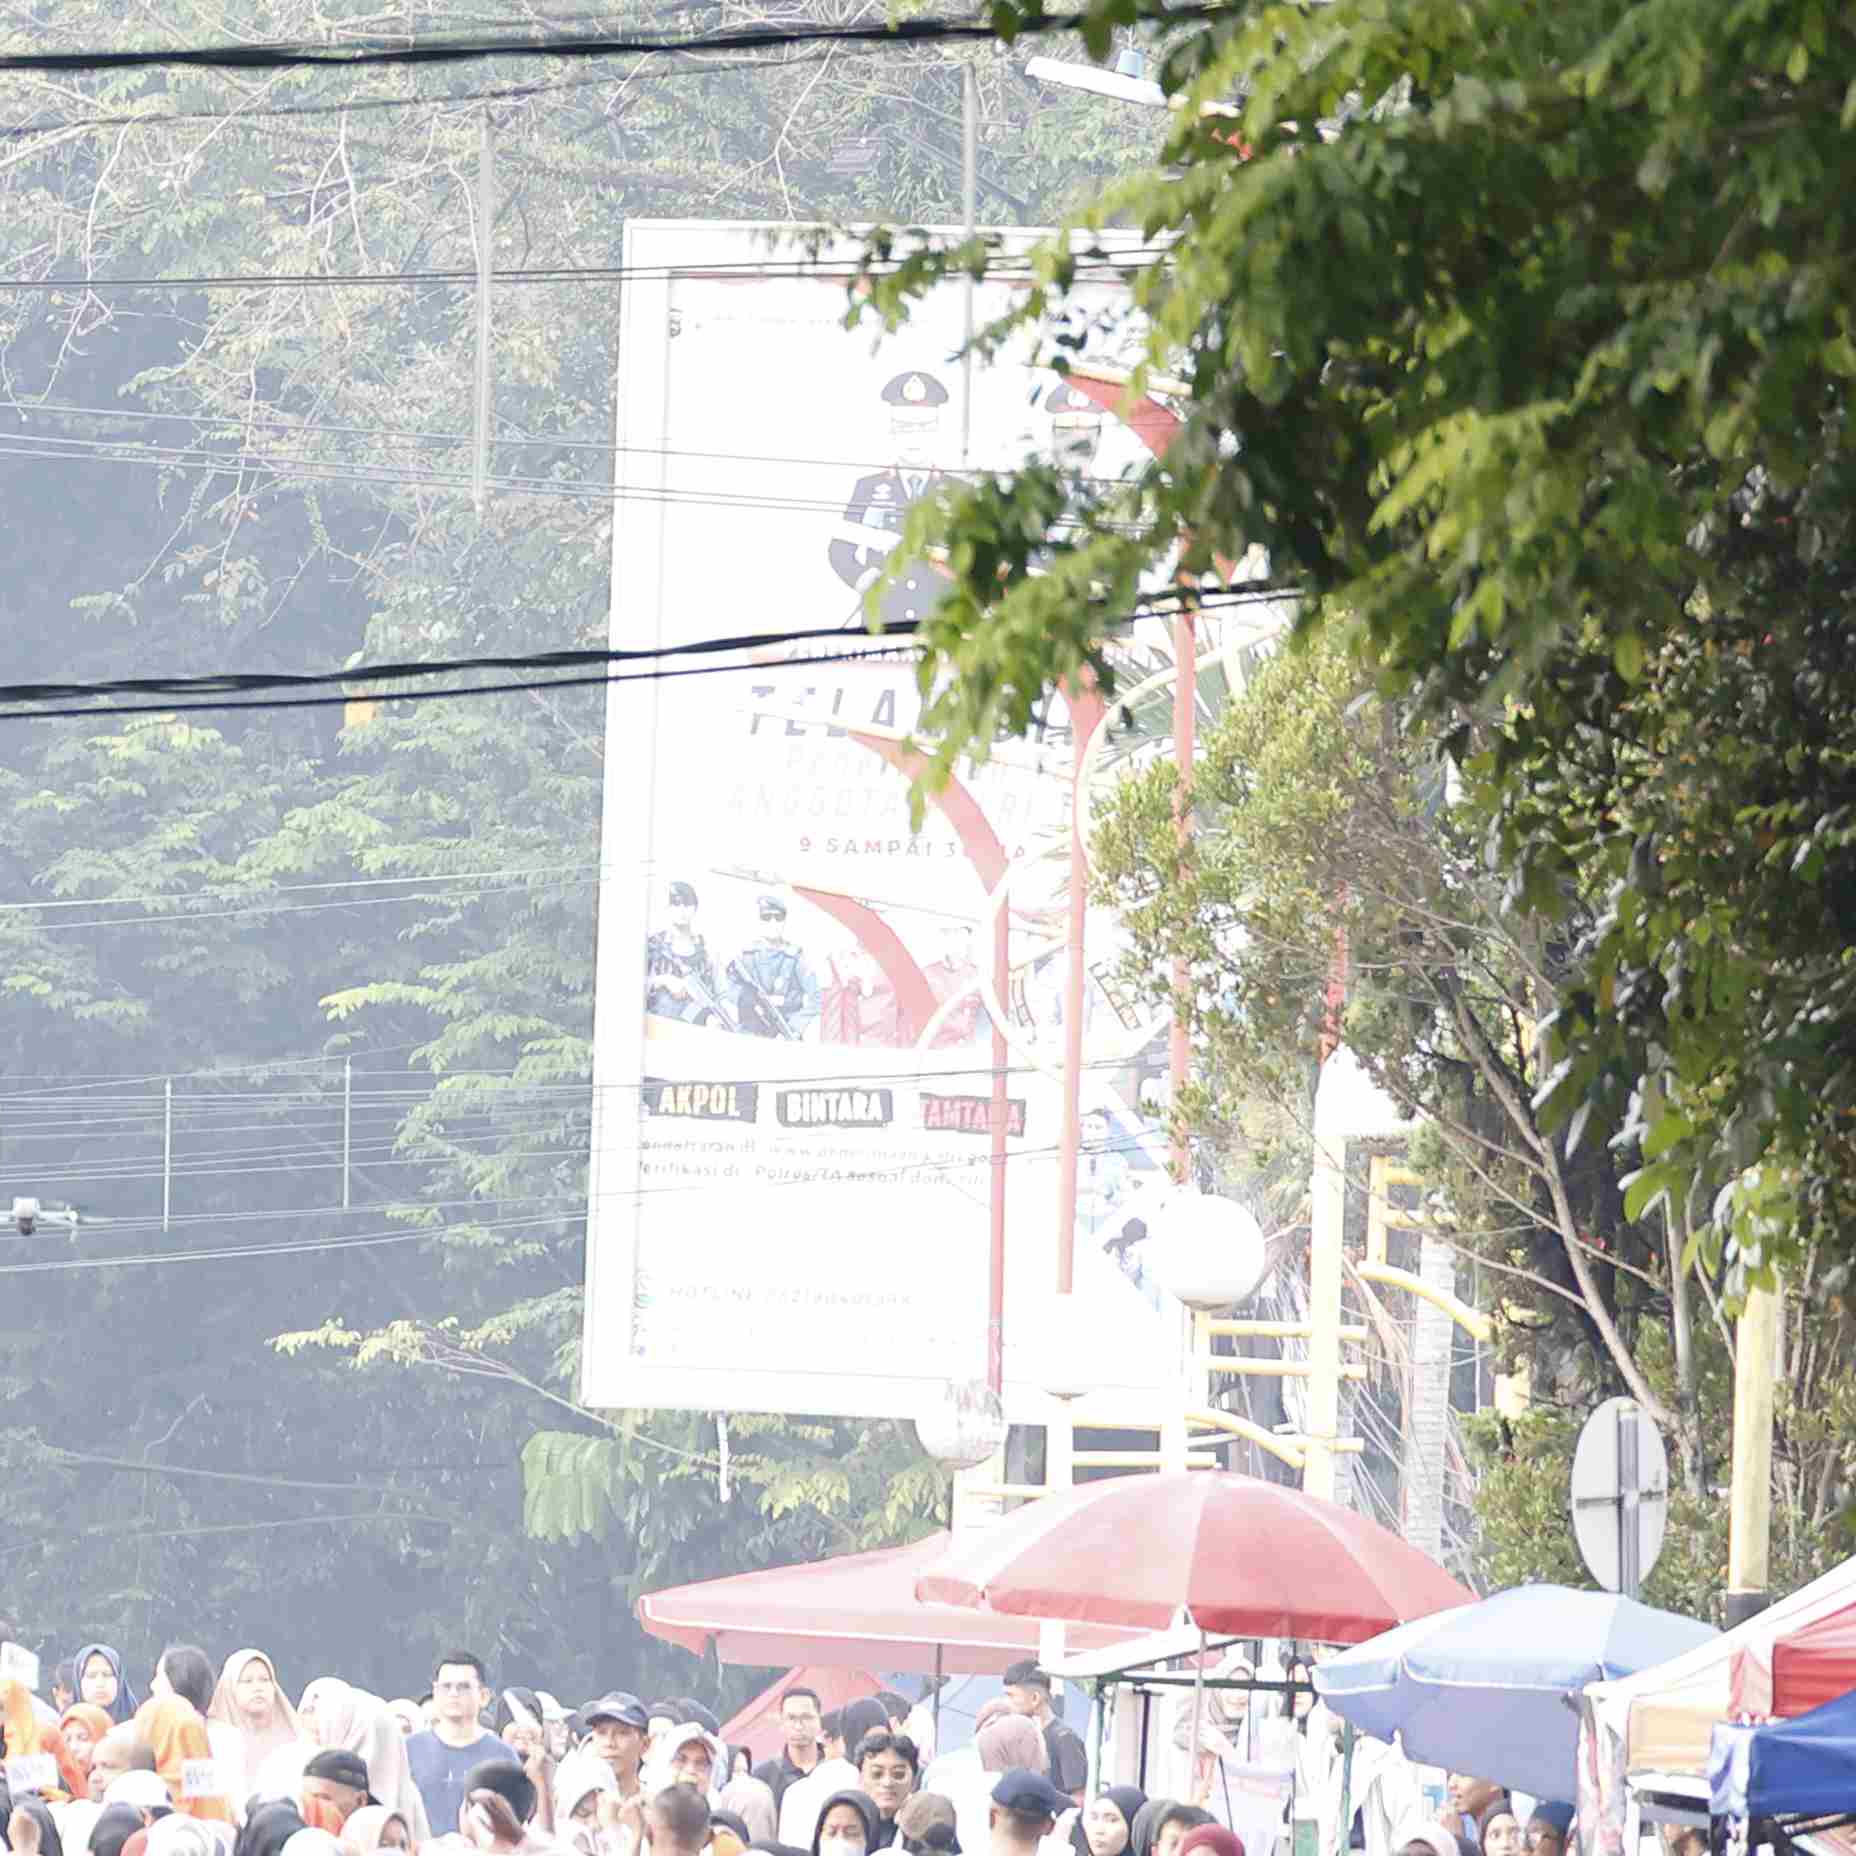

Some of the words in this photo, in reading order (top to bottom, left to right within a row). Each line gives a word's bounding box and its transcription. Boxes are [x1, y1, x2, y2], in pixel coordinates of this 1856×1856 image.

[660, 1084, 740, 1117] AKPOL
[786, 1091, 883, 1123] BINTARA
[919, 1097, 1021, 1132] TAMTAA
